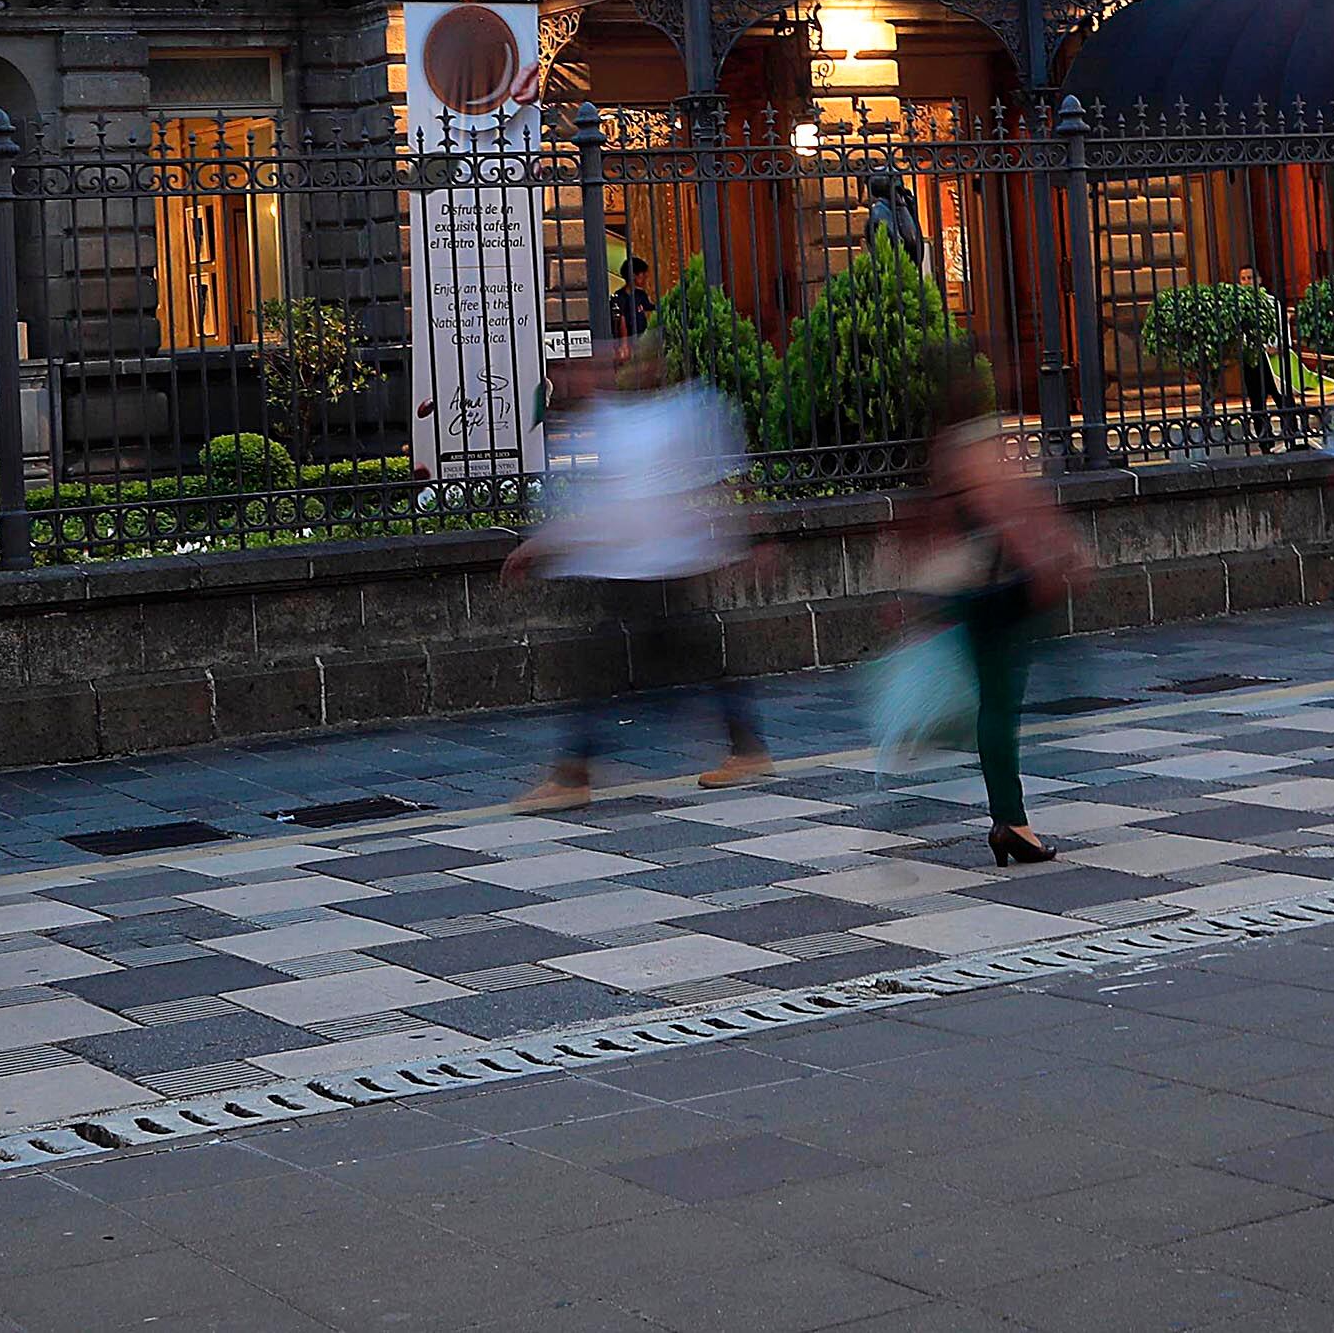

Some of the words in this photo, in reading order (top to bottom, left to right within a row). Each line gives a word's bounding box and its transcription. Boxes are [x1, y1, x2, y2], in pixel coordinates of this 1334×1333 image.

[441, 204, 483, 216] Dsfrut
[485, 203, 498, 215] de
[507, 221, 520, 231] en
[430, 237, 440, 249] el
[442, 237, 475, 249] Teatro
[479, 236, 525, 248] acional.
[463, 284, 477, 294] an
[479, 282, 524, 295] xquite
[448, 299, 479, 312] cffee
[493, 298, 510, 310] the
[430, 316, 474, 329] National
[476, 315, 515, 327] Teatr
[517, 314, 529, 327] of
[451, 333, 480, 345] Costa
[483, 332, 507, 344] ica.
